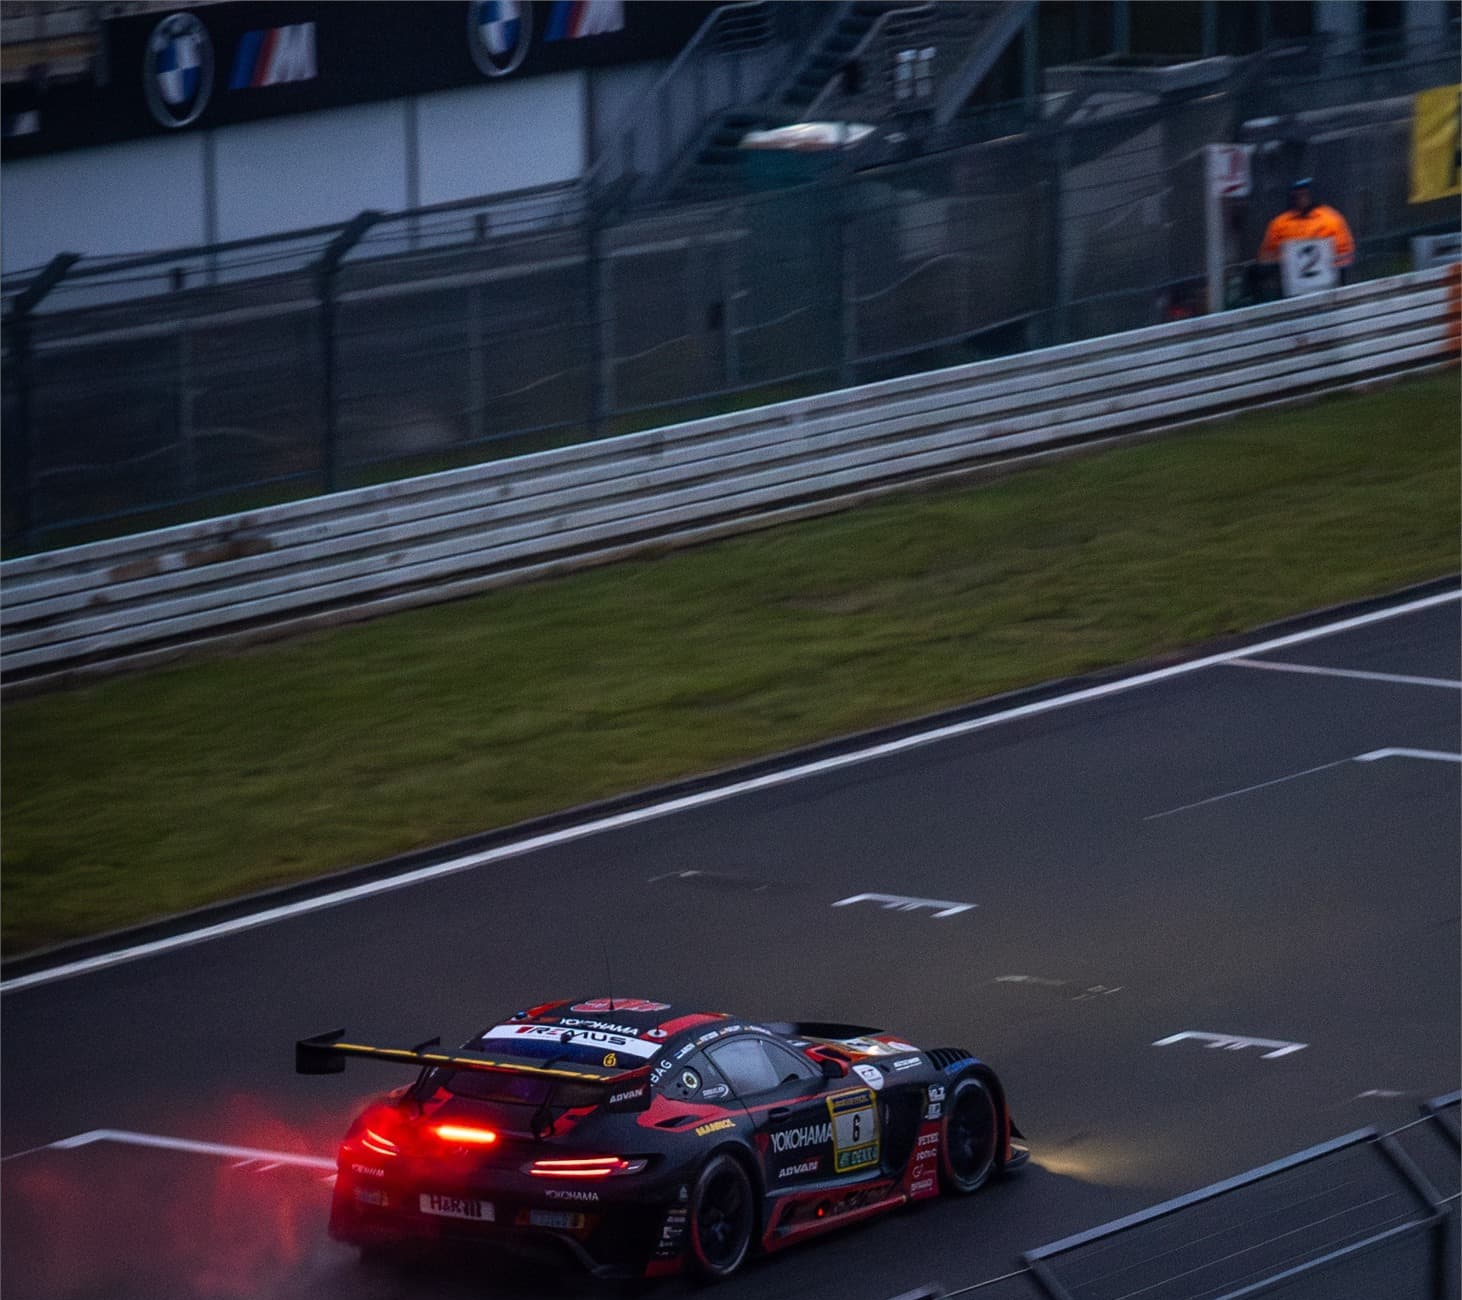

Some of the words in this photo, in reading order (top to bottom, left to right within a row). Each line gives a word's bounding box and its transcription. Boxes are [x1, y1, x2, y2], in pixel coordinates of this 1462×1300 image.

[1299, 244, 1323, 279] 2
[528, 1025, 627, 1046] REMUS
[559, 1016, 639, 1036] YOKOHAMA
[602, 1052, 617, 1068] 6
[608, 1087, 644, 1104] ADVAN
[852, 1114, 861, 1141] 6
[770, 1122, 833, 1154] YOKOHAMA
[778, 1160, 819, 1178] ADVAN
[543, 1189, 600, 1201] YOKOHAMA
